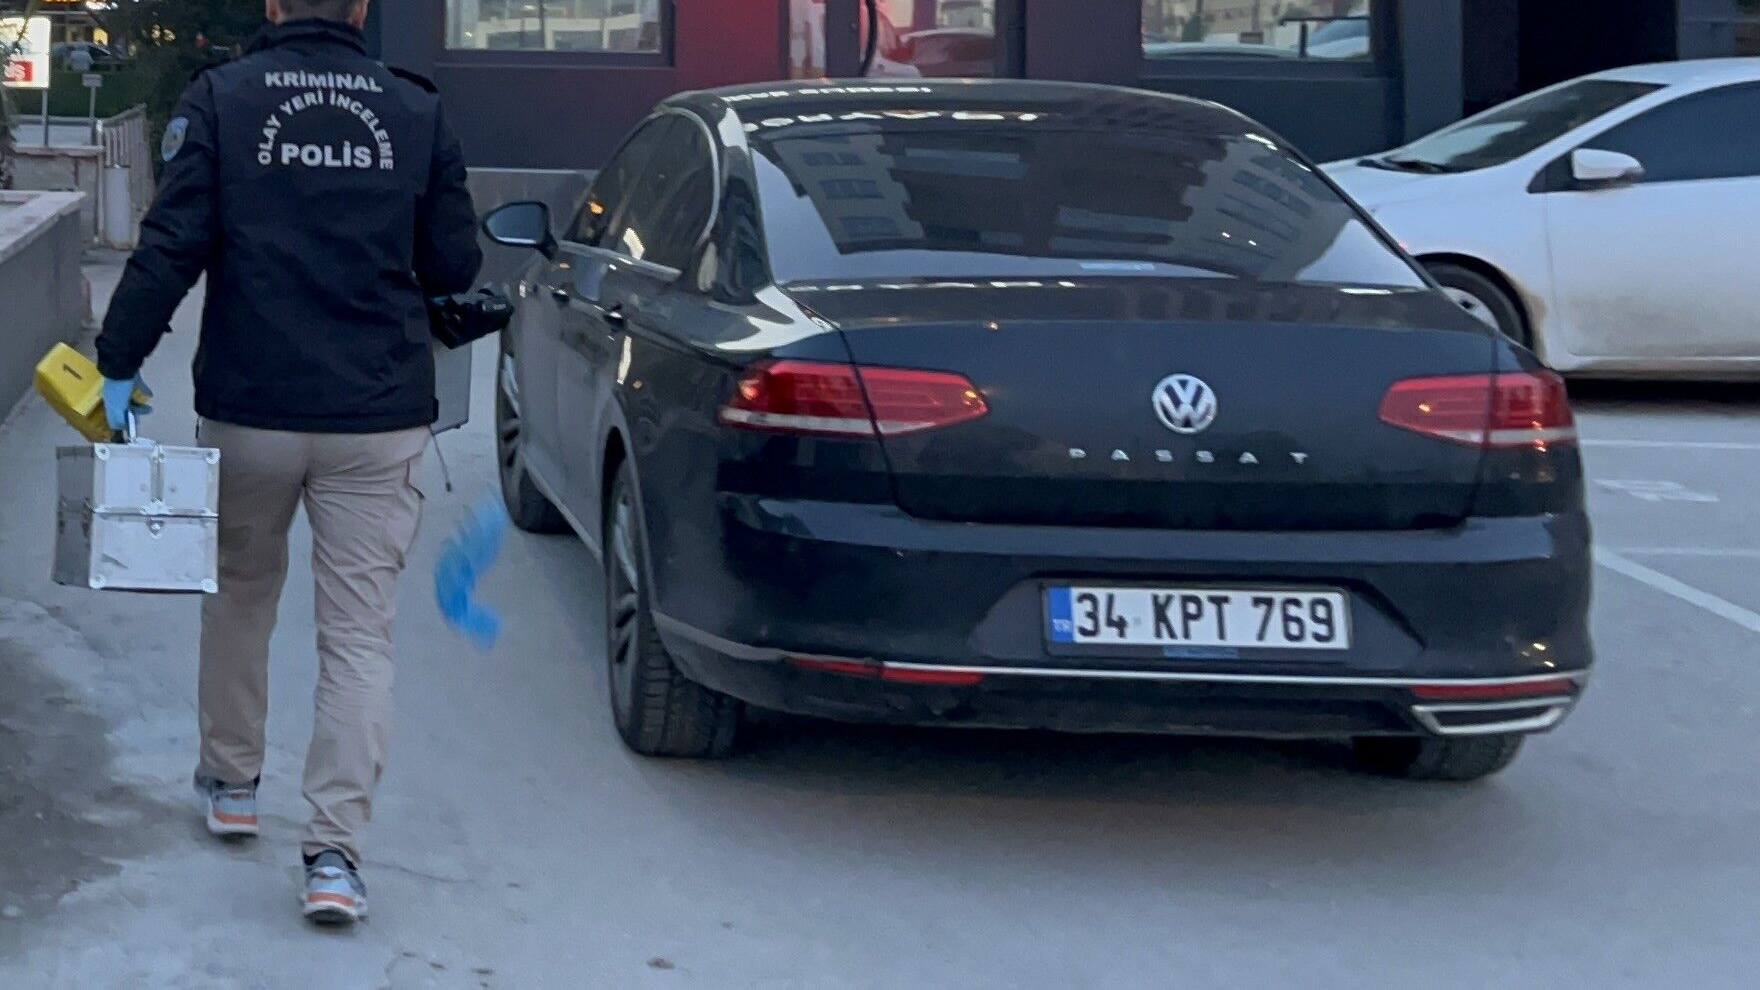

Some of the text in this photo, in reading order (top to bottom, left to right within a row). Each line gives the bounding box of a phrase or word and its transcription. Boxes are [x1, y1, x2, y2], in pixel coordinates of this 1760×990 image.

[264, 69, 384, 94] KRİMİNAL
[257, 88, 395, 172] OLAY YERİ İNCELEME
[281, 140, 373, 170] POLİS
[62, 362, 83, 381] 1
[1067, 447, 1309, 465] PASSAT
[1075, 592, 1337, 644] 34 KPT 769
